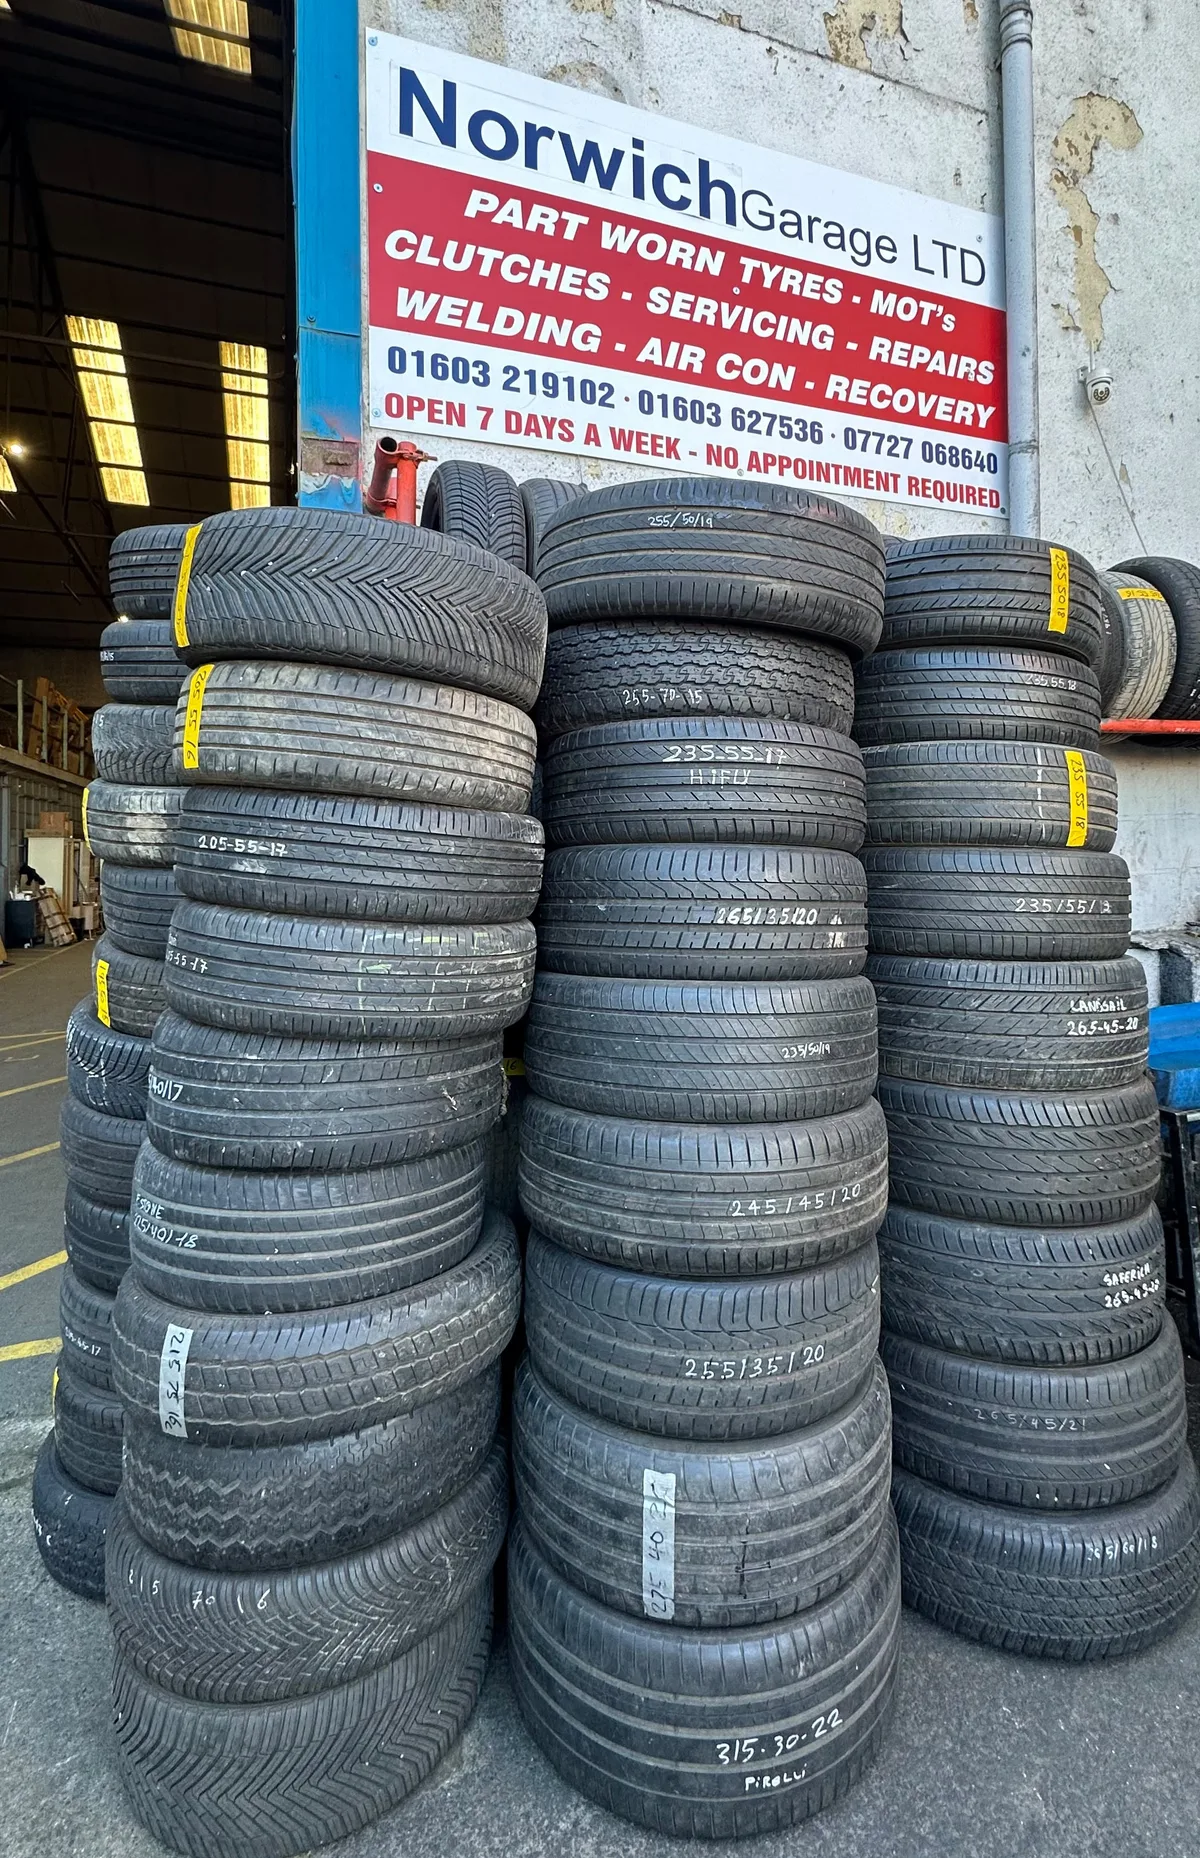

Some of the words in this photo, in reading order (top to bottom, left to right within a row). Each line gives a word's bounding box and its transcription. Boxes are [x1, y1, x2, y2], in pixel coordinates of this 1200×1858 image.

[463, 189, 590, 241] PART
[600, 220, 726, 277] WORN
[739, 256, 844, 305] TYRES
[869, 289, 957, 333] MOT's
[913, 234, 986, 288] LTD
[384, 229, 611, 301] CLUTCHES
[645, 285, 835, 351] SERVICING
[869, 335, 996, 386] REPAIRS
[396, 286, 603, 354] WELDING
[635, 336, 707, 374] AIR
[716, 352, 797, 392] CON
[825, 374, 997, 429] RECOVERY
[387, 345, 491, 388] 01603
[502, 364, 616, 410] 219102
[637, 388, 722, 428] 01603
[731, 406, 824, 445] 627536
[843, 426, 914, 460] 07727
[921, 440, 999, 475] 068640
[384, 392, 466, 428] OPEN
[476, 405, 495, 431] 7
[504, 410, 576, 443] DAYS
[582, 421, 602, 447] A
[610, 427, 681, 461] WEEK
[705, 442, 740, 471] NO
[746, 450, 901, 494] APPOINTMENT
[907, 474, 1001, 510] REQUIRED
[1057, 584, 1067, 604] 50
[1057, 607, 1066, 619] 18
[188, 708, 198, 732] 55
[1070, 758, 1085, 785] 235
[1074, 791, 1086, 811] 55
[1075, 816, 1086, 830] 18
[198, 834, 289, 858] 205-55-17
[168, 1331, 185, 1373] 215
[166, 1380, 180, 1405] 75
[648, 1531, 665, 1561] 40
